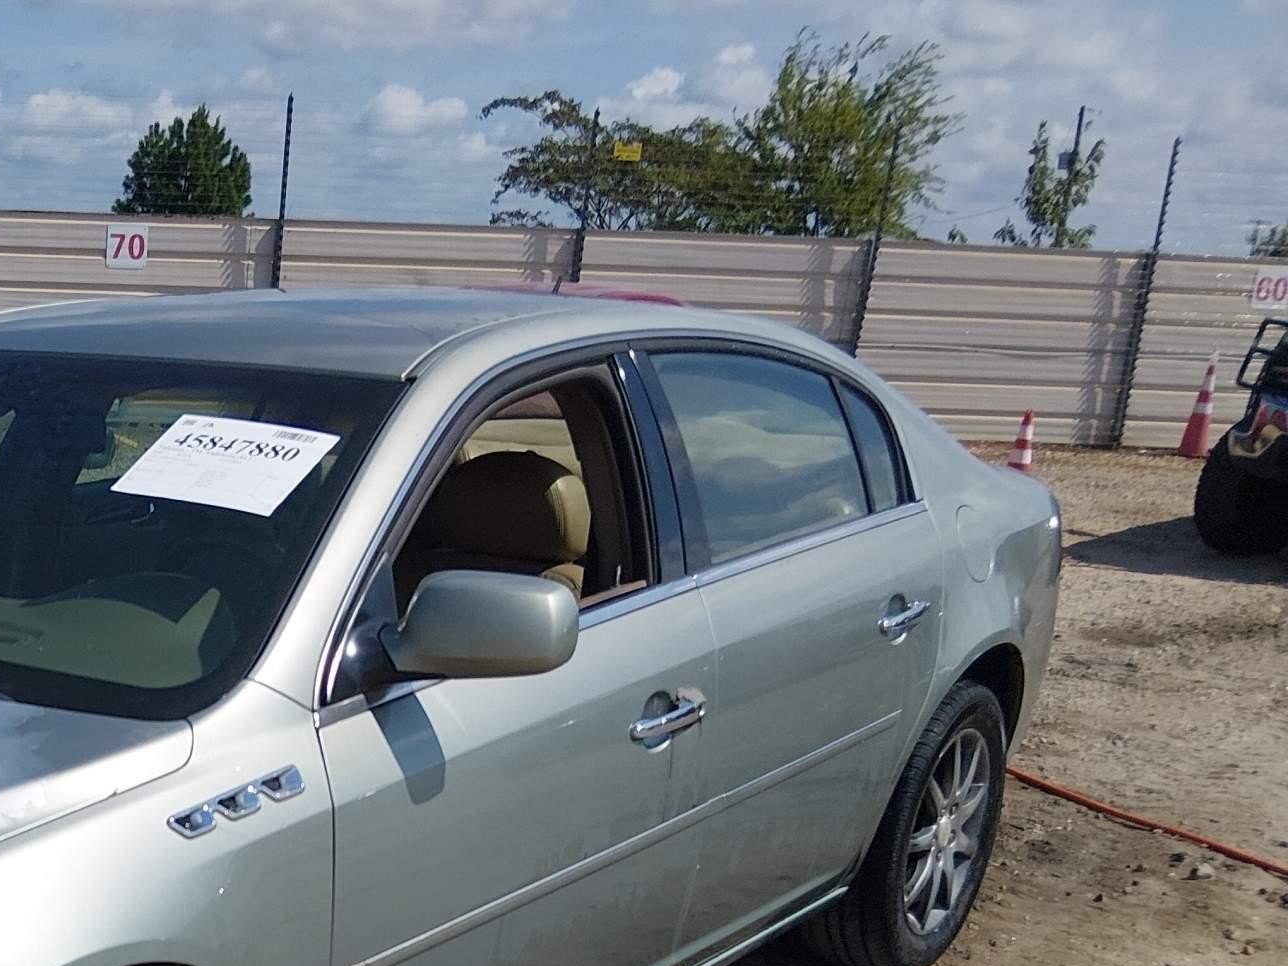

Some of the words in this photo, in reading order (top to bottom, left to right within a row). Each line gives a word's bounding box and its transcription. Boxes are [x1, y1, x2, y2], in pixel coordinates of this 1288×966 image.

[110, 233, 145, 260] 70
[1256, 276, 1288, 302] 60
[173, 432, 301, 463] 45847880
